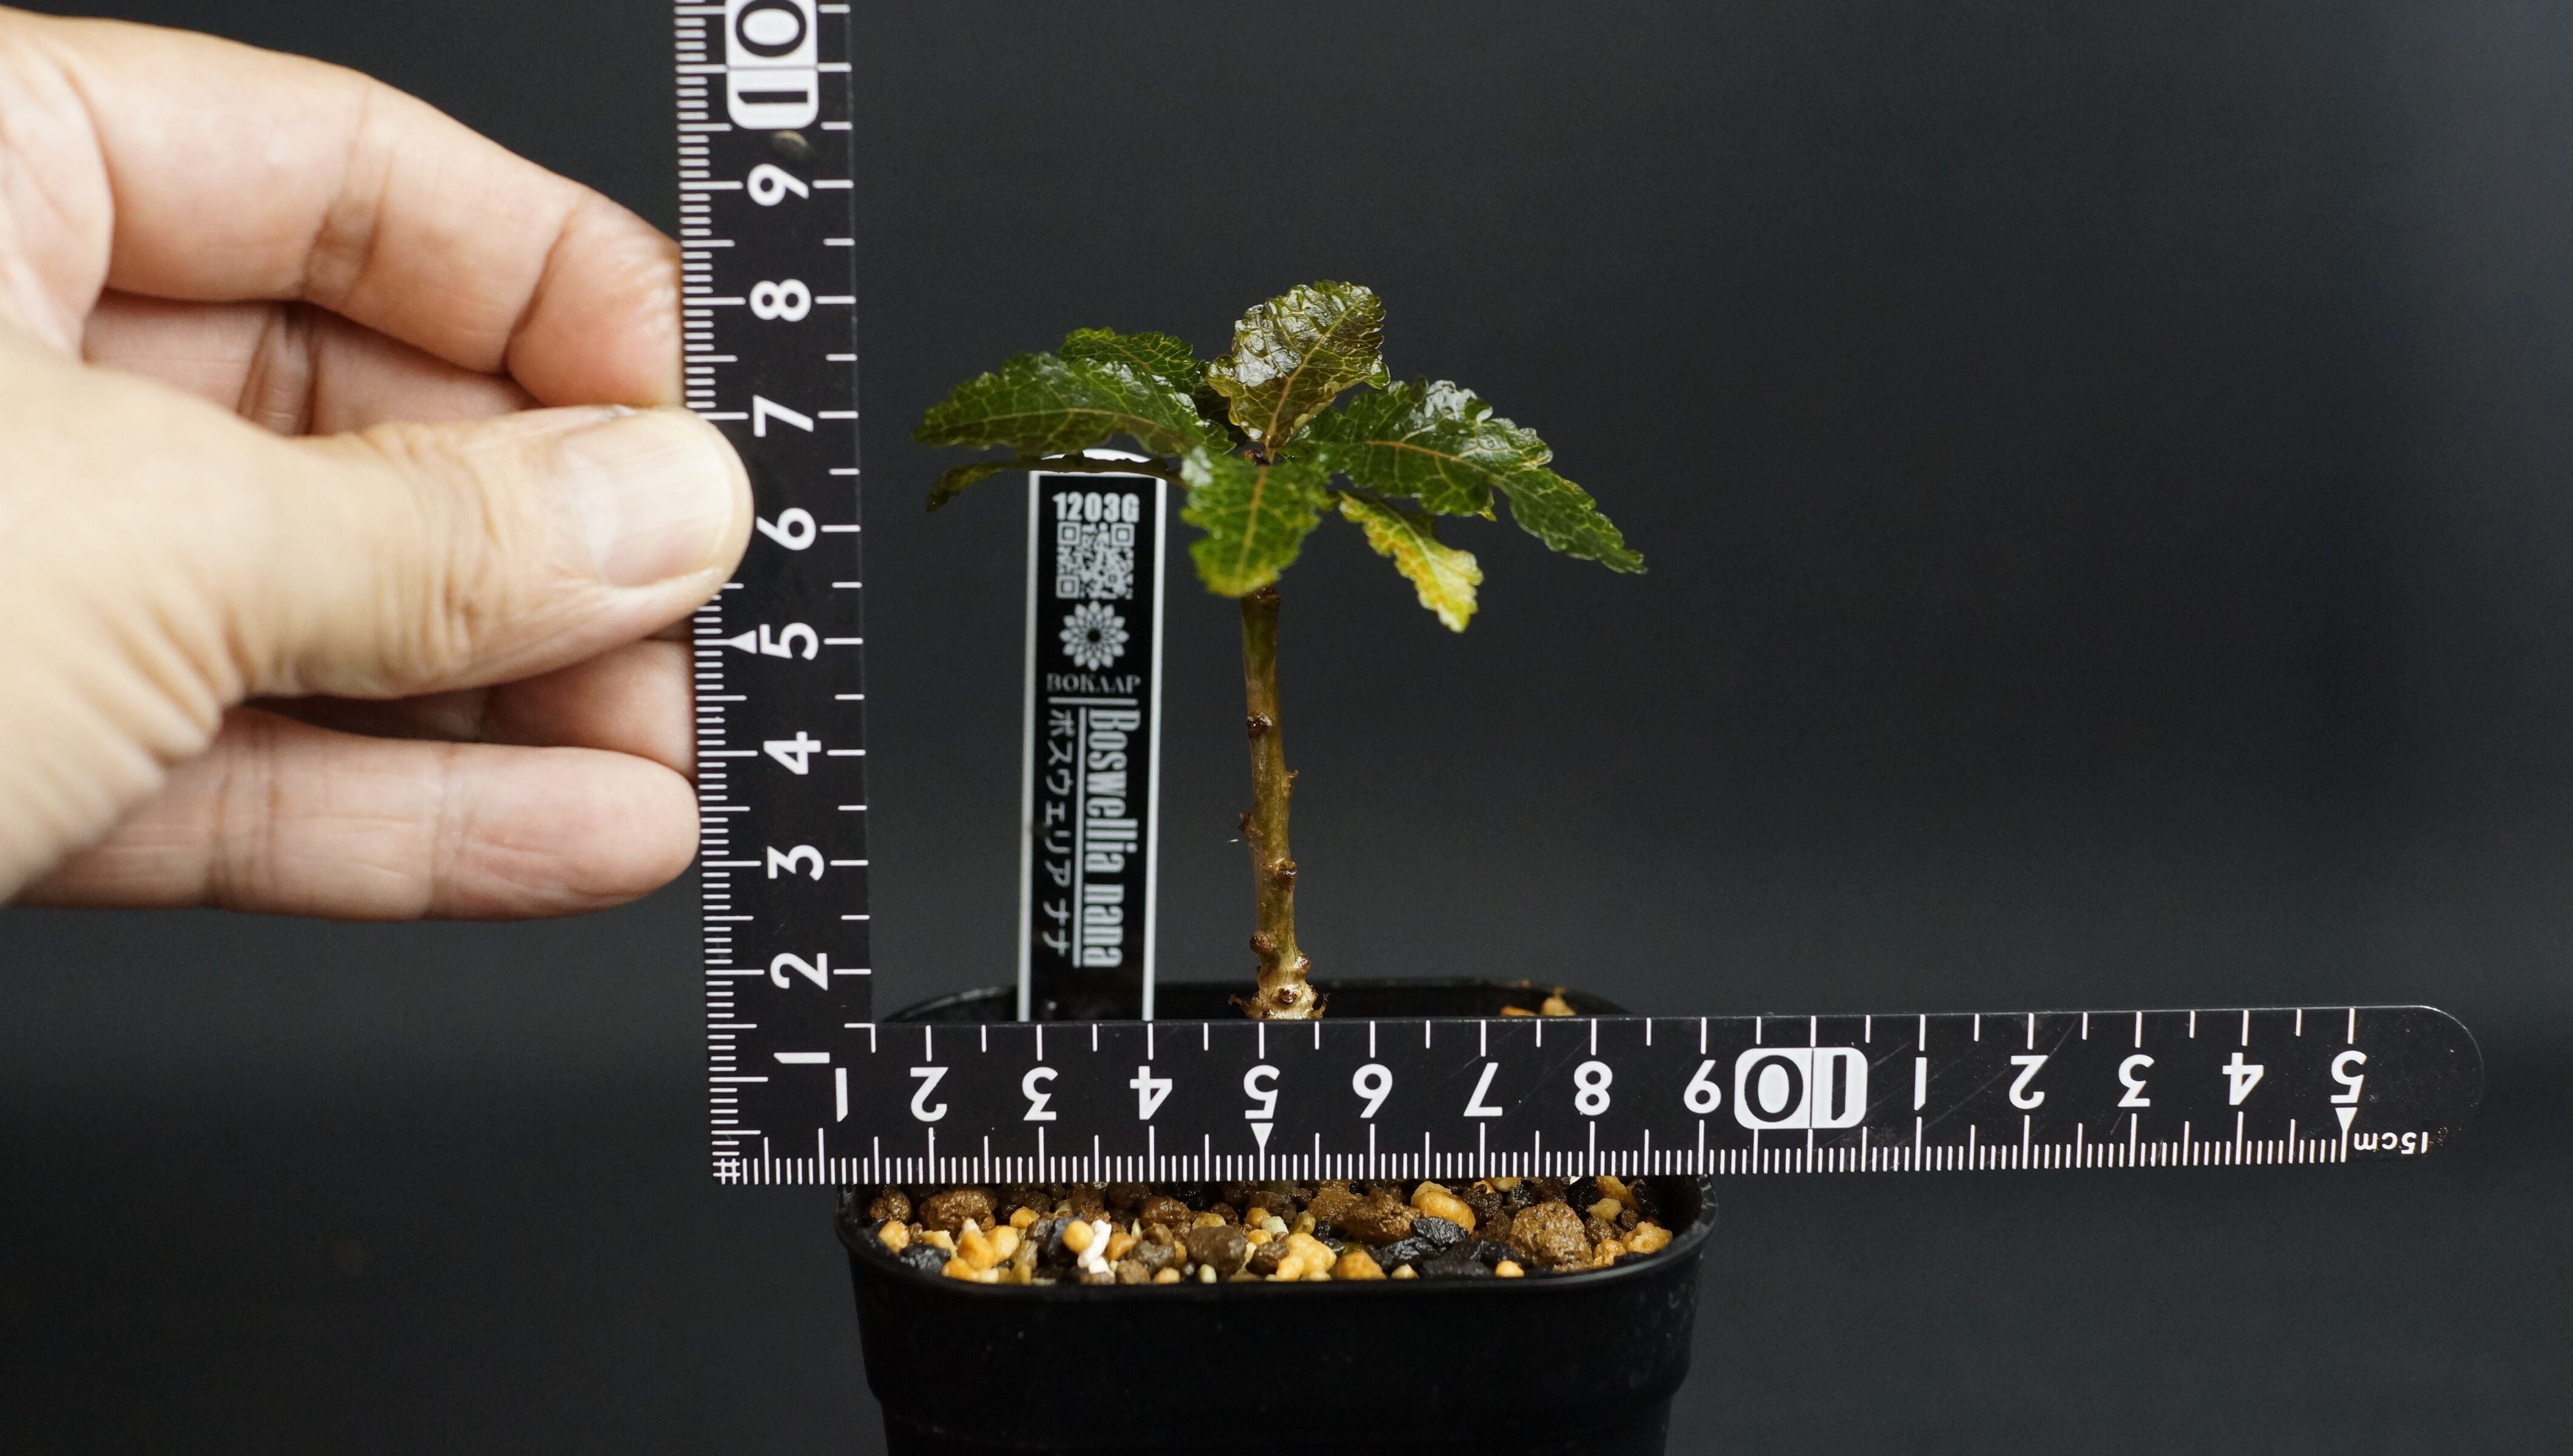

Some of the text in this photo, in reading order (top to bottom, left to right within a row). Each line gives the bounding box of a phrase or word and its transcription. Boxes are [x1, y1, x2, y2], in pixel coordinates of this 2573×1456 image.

[735, 0, 808, 104] 10
[747, 163, 810, 206] 9
[749, 278, 811, 322] 8
[752, 394, 814, 437] 7
[756, 507, 816, 551] 6
[1052, 491, 1140, 524] 1203G
[759, 622, 819, 660] 5
[1047, 673, 1141, 693] BOKAAP
[763, 731, 822, 775] 4
[766, 844, 825, 881] 3
[1083, 708, 1141, 967] Boswellia nana
[770, 952, 828, 991] 2
[773, 1052, 830, 1064] 1
[1913, 1057, 1927, 1111] 1
[2009, 1054, 2049, 1110] 2
[2117, 1054, 2155, 1108] 3
[2222, 1052, 2264, 1105] 4
[2330, 1050, 2367, 1104] 5
[835, 1067, 848, 1122] 1
[910, 1067, 948, 1122] 2
[1022, 1067, 1058, 1121] 3
[1129, 1065, 1173, 1120] 4
[1243, 1065, 1280, 1119] 5
[1352, 1063, 1393, 1119] 6
[1463, 1062, 1503, 1117] 7
[1574, 1060, 1613, 1116] 8
[1683, 1059, 1722, 1114] 9
[1743, 1054, 1848, 1123] 10
[2353, 1131, 2429, 1154] 15cm
